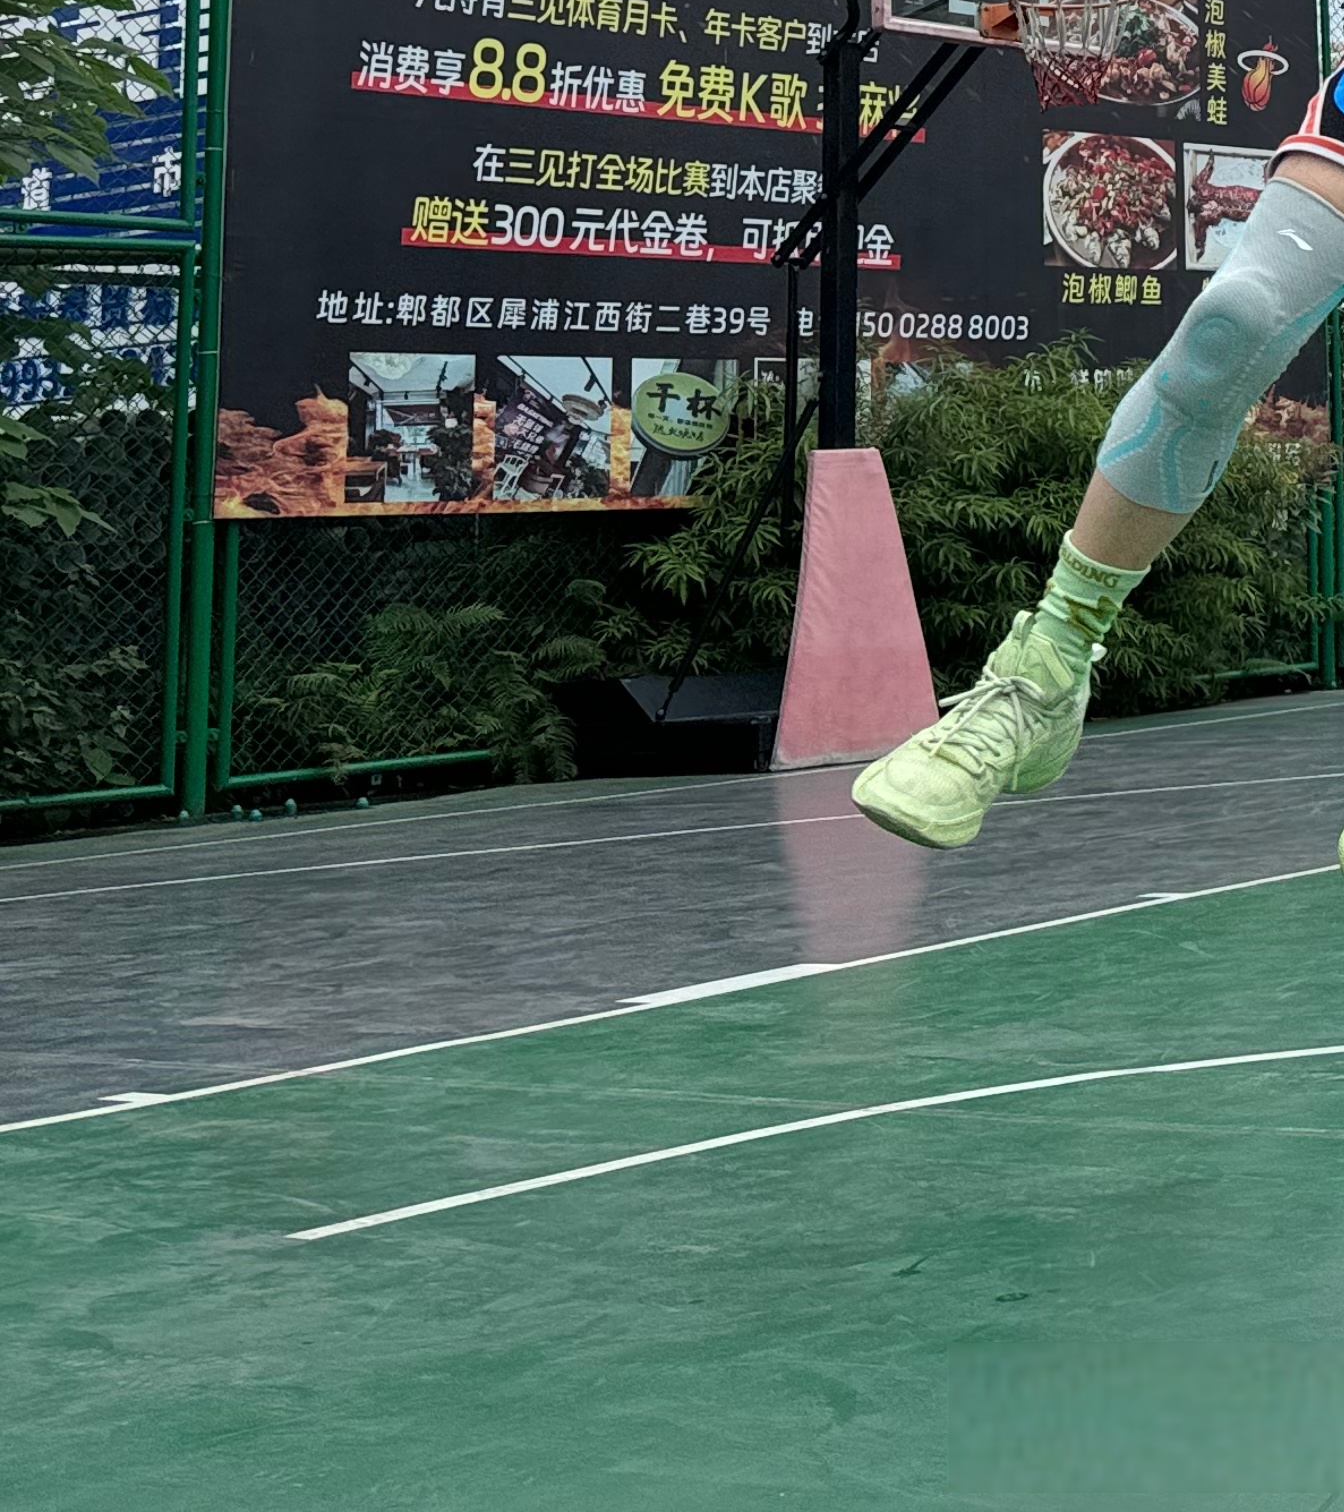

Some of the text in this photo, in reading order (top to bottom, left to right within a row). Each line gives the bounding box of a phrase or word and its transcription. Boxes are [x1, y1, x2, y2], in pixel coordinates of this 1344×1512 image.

[357, 37, 921, 137] 消费享8.8折优惠 免费K歌麻
[472, 143, 823, 205] 在三见打全场比赛到本店聚
[1062, 272, 1162, 306] 泡椒鲫鱼
